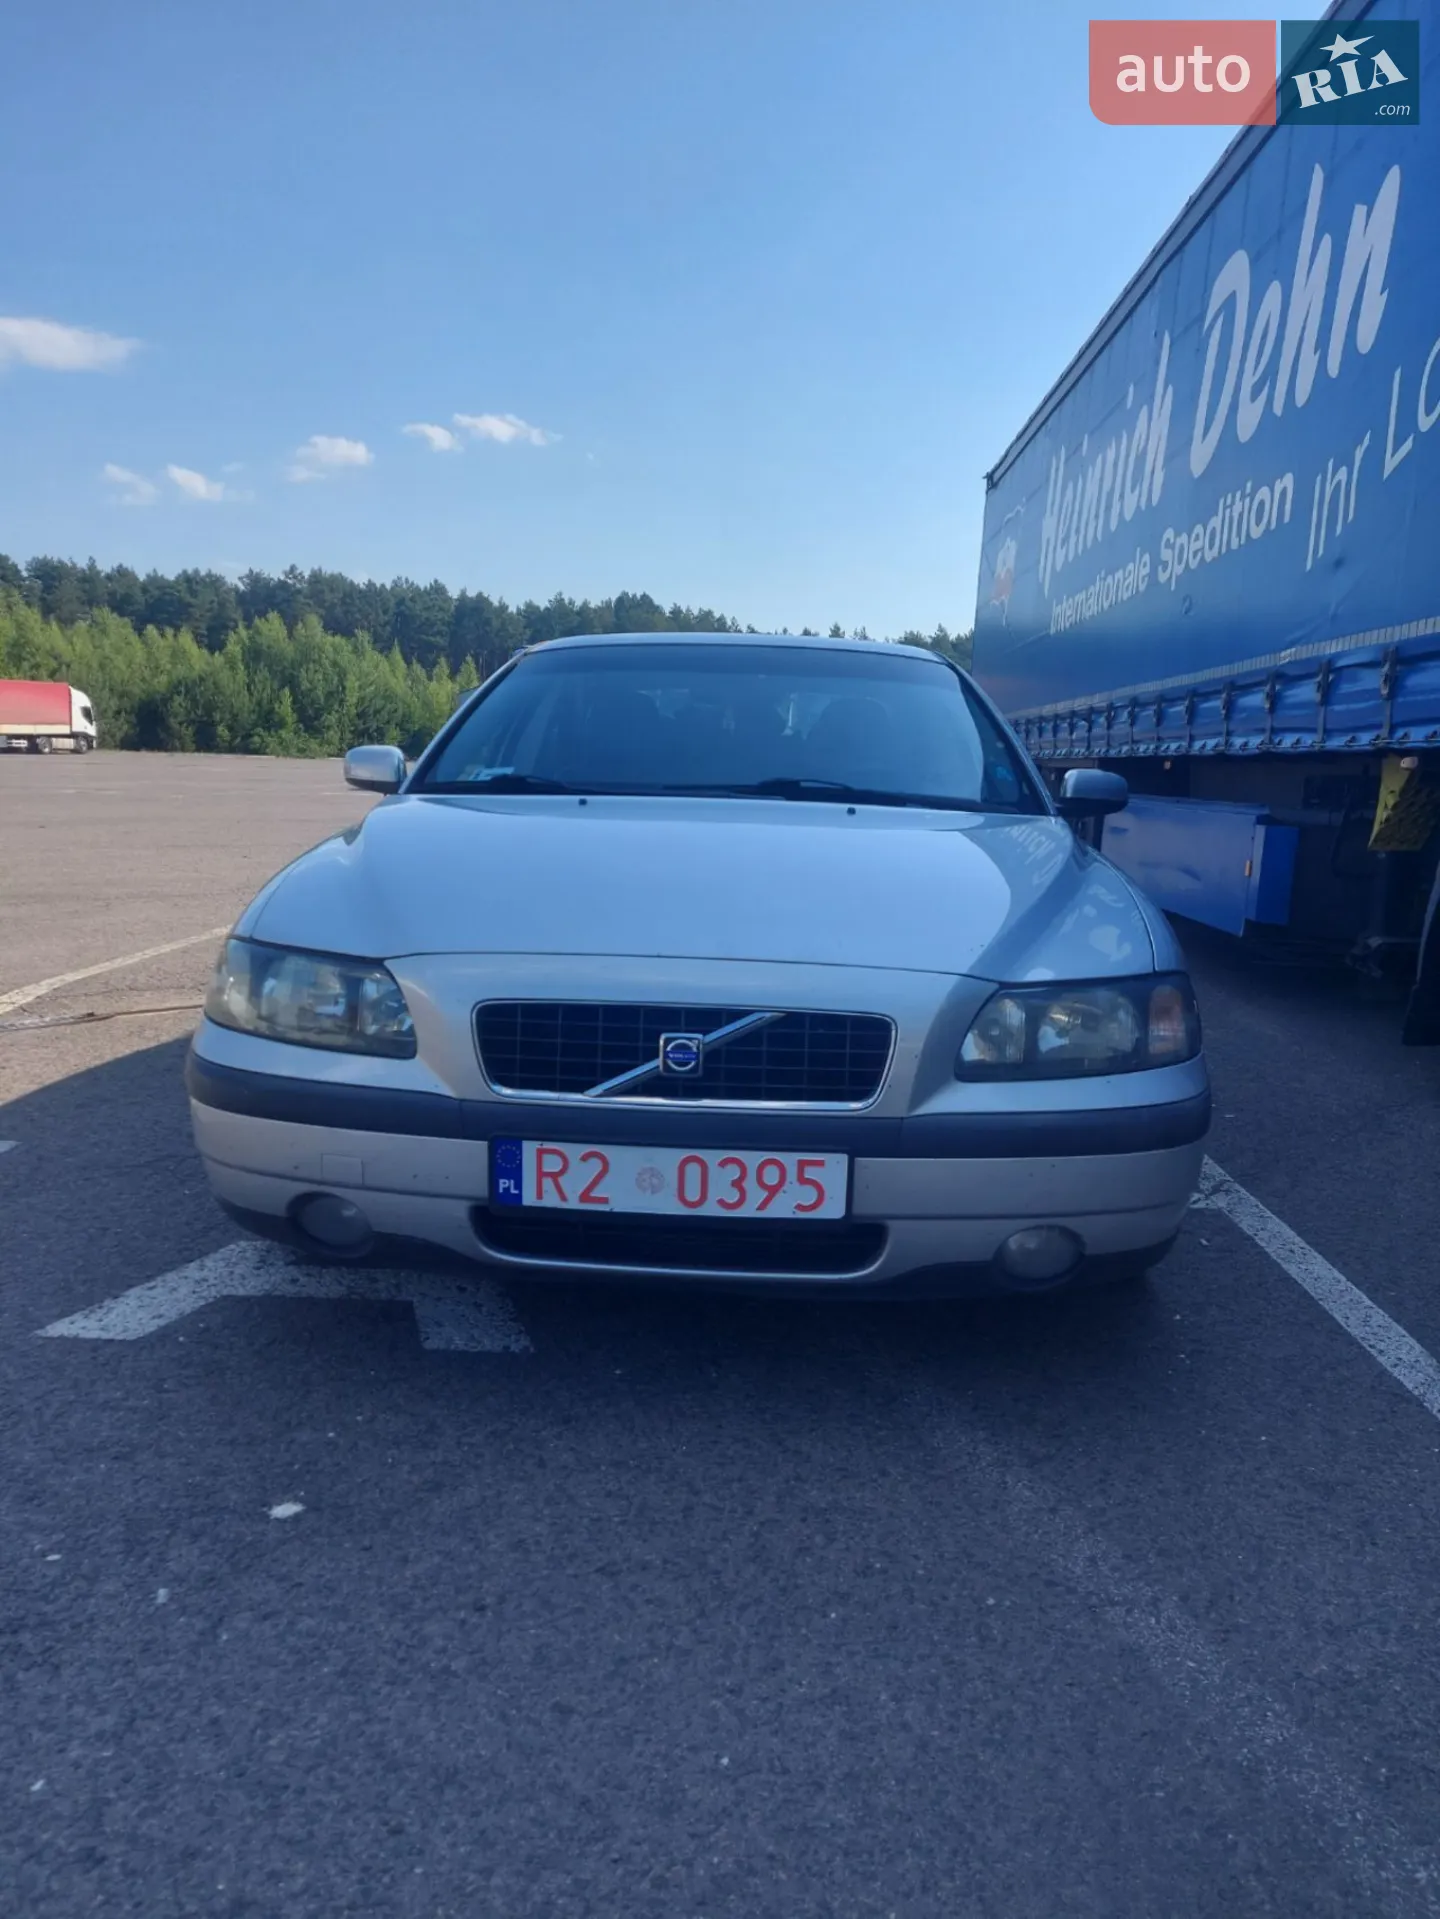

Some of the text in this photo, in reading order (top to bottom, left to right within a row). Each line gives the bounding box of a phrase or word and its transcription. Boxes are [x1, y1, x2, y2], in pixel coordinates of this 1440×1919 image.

[1039, 163, 1400, 598] Heinrich Dehn
[1050, 472, 1294, 634] Internationale Spedition
[1306, 429, 1371, 572] Ihr
[499, 1178, 519, 1194] PL
[535, 1147, 826, 1213] R2 0395
